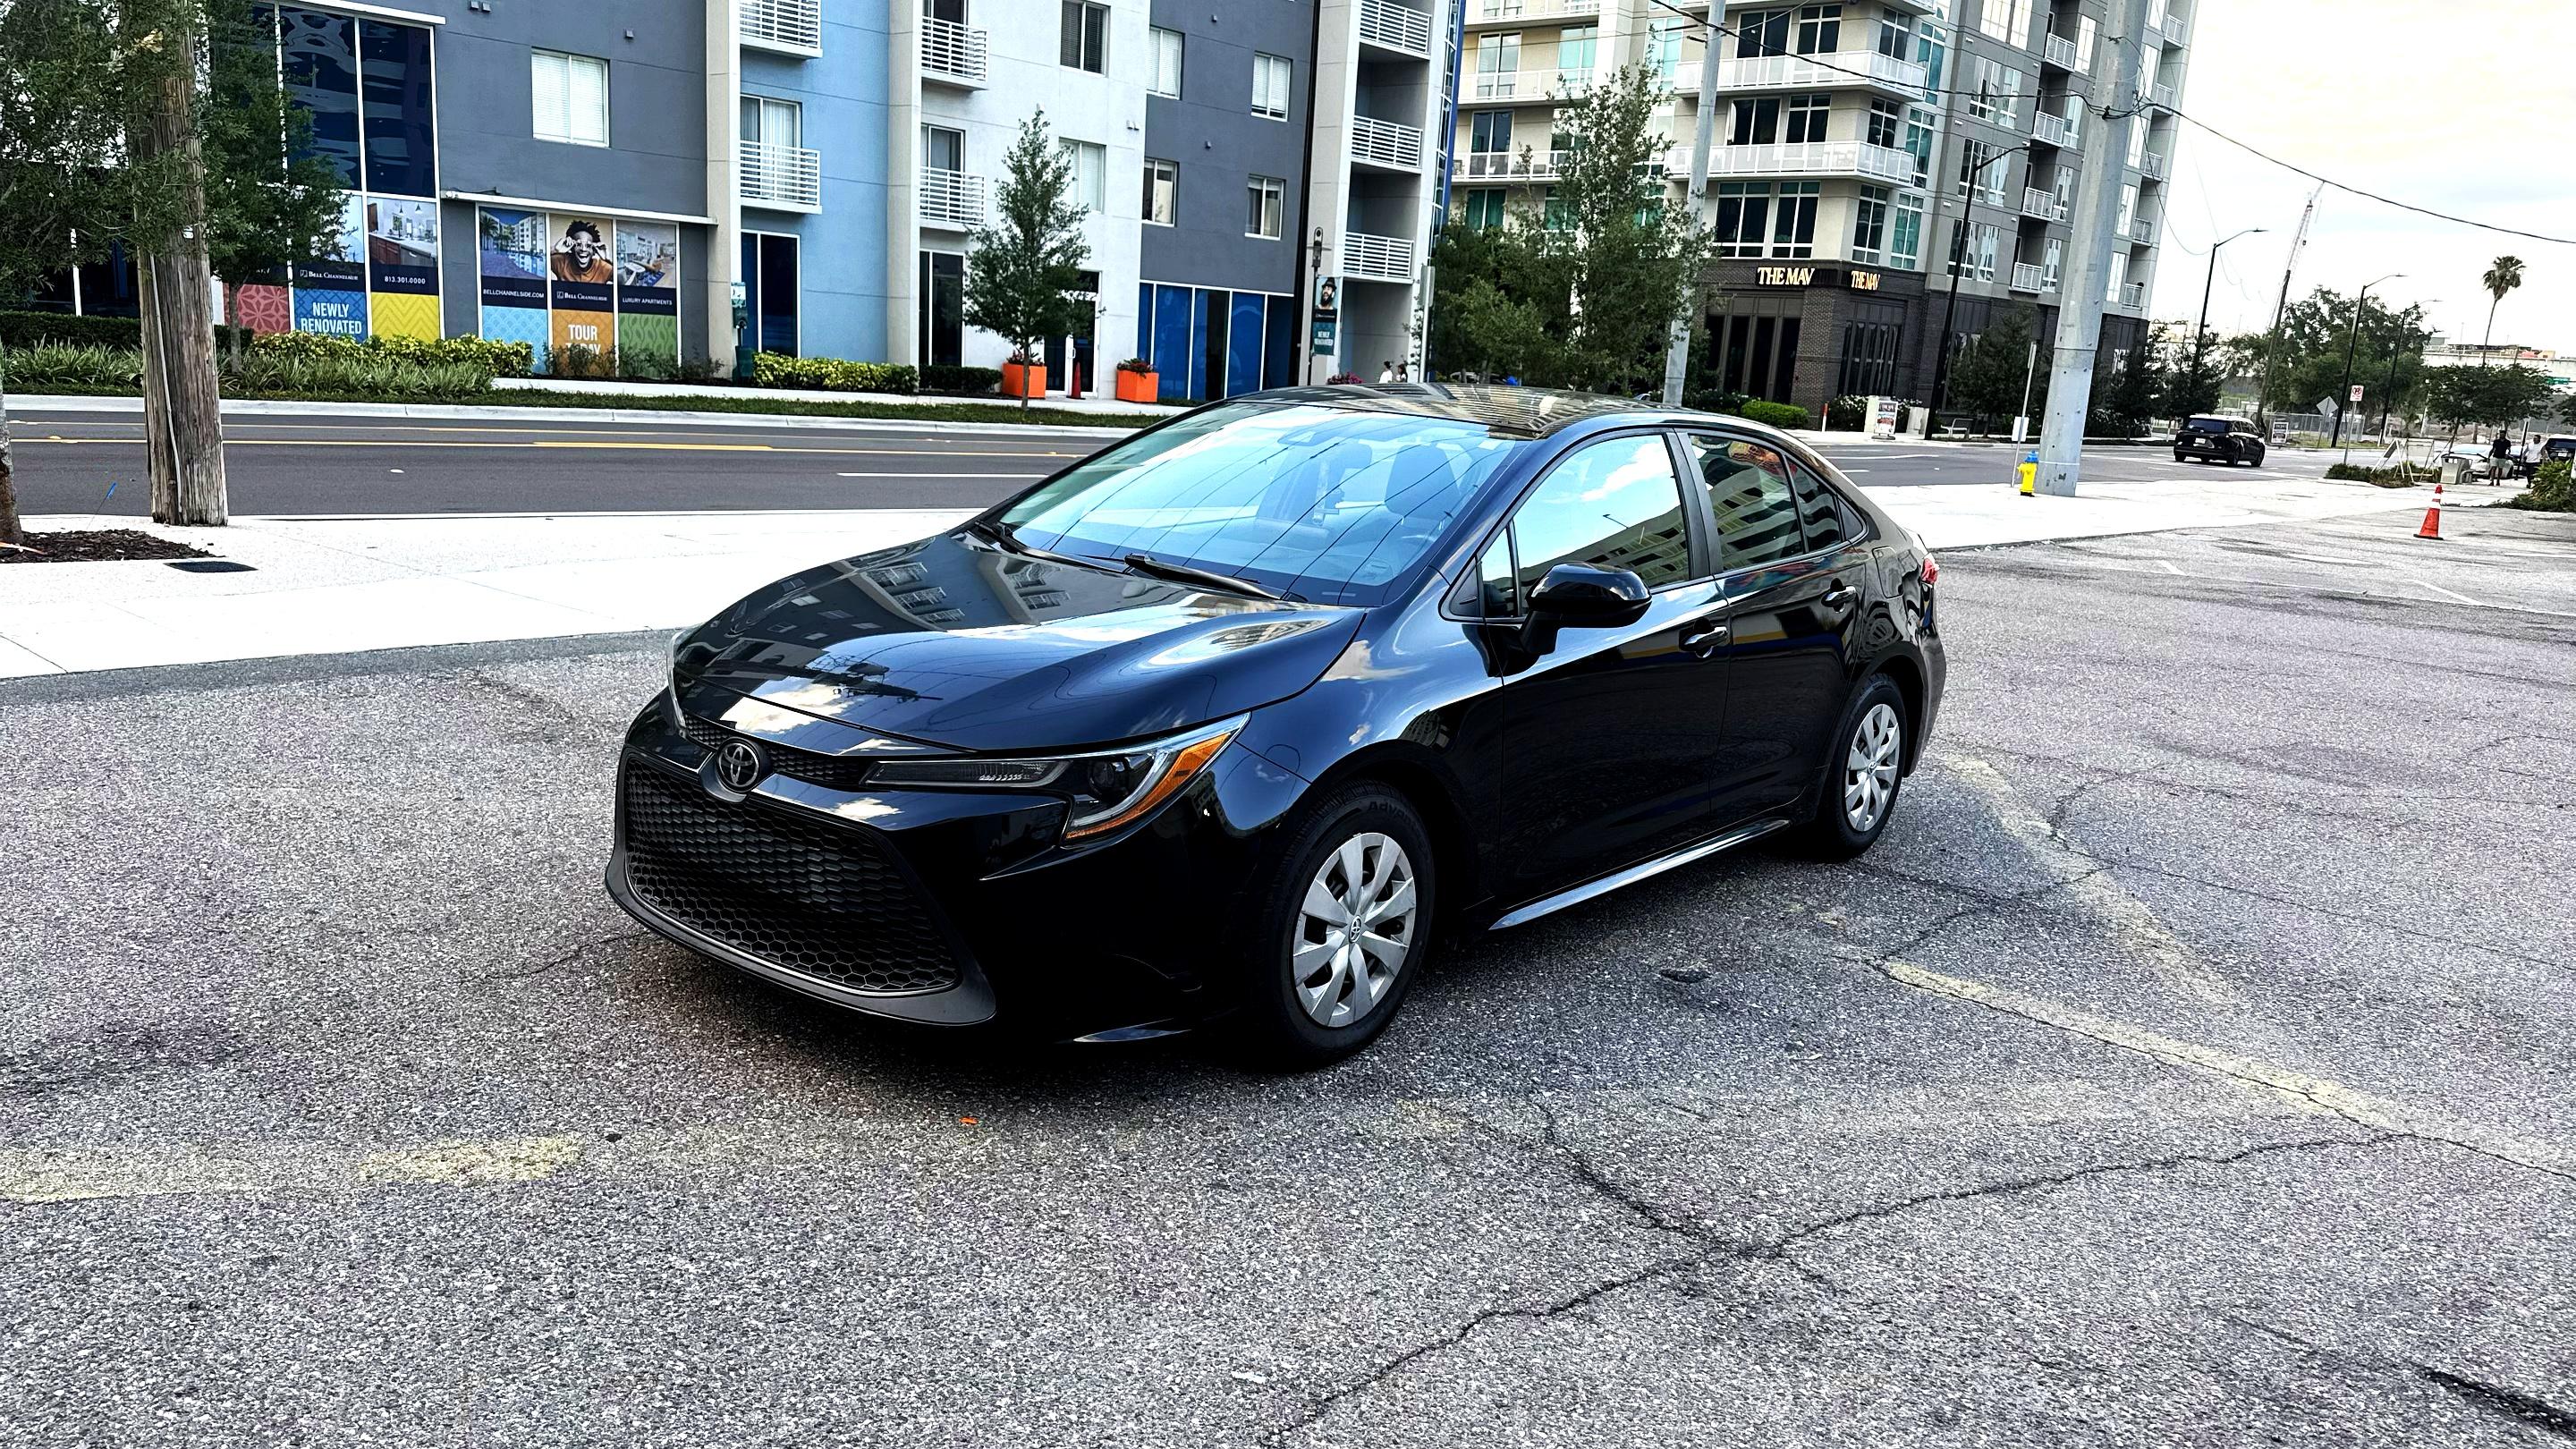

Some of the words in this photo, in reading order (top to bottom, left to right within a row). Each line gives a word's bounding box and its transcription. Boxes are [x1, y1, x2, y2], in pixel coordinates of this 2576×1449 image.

[384, 275, 426, 284] 813.301.0000
[1758, 267, 1786, 285] THE
[1785, 267, 1815, 286] MAV
[1851, 270, 1867, 289] THE
[1866, 272, 1880, 291] MAV
[483, 289, 545, 298] BELLCHANNELSIDE.COM
[312, 301, 350, 318] NEWLY
[641, 298, 673, 306] APARTMENTS
[300, 318, 362, 334] RENOVATED
[567, 324, 598, 341] TOUR
